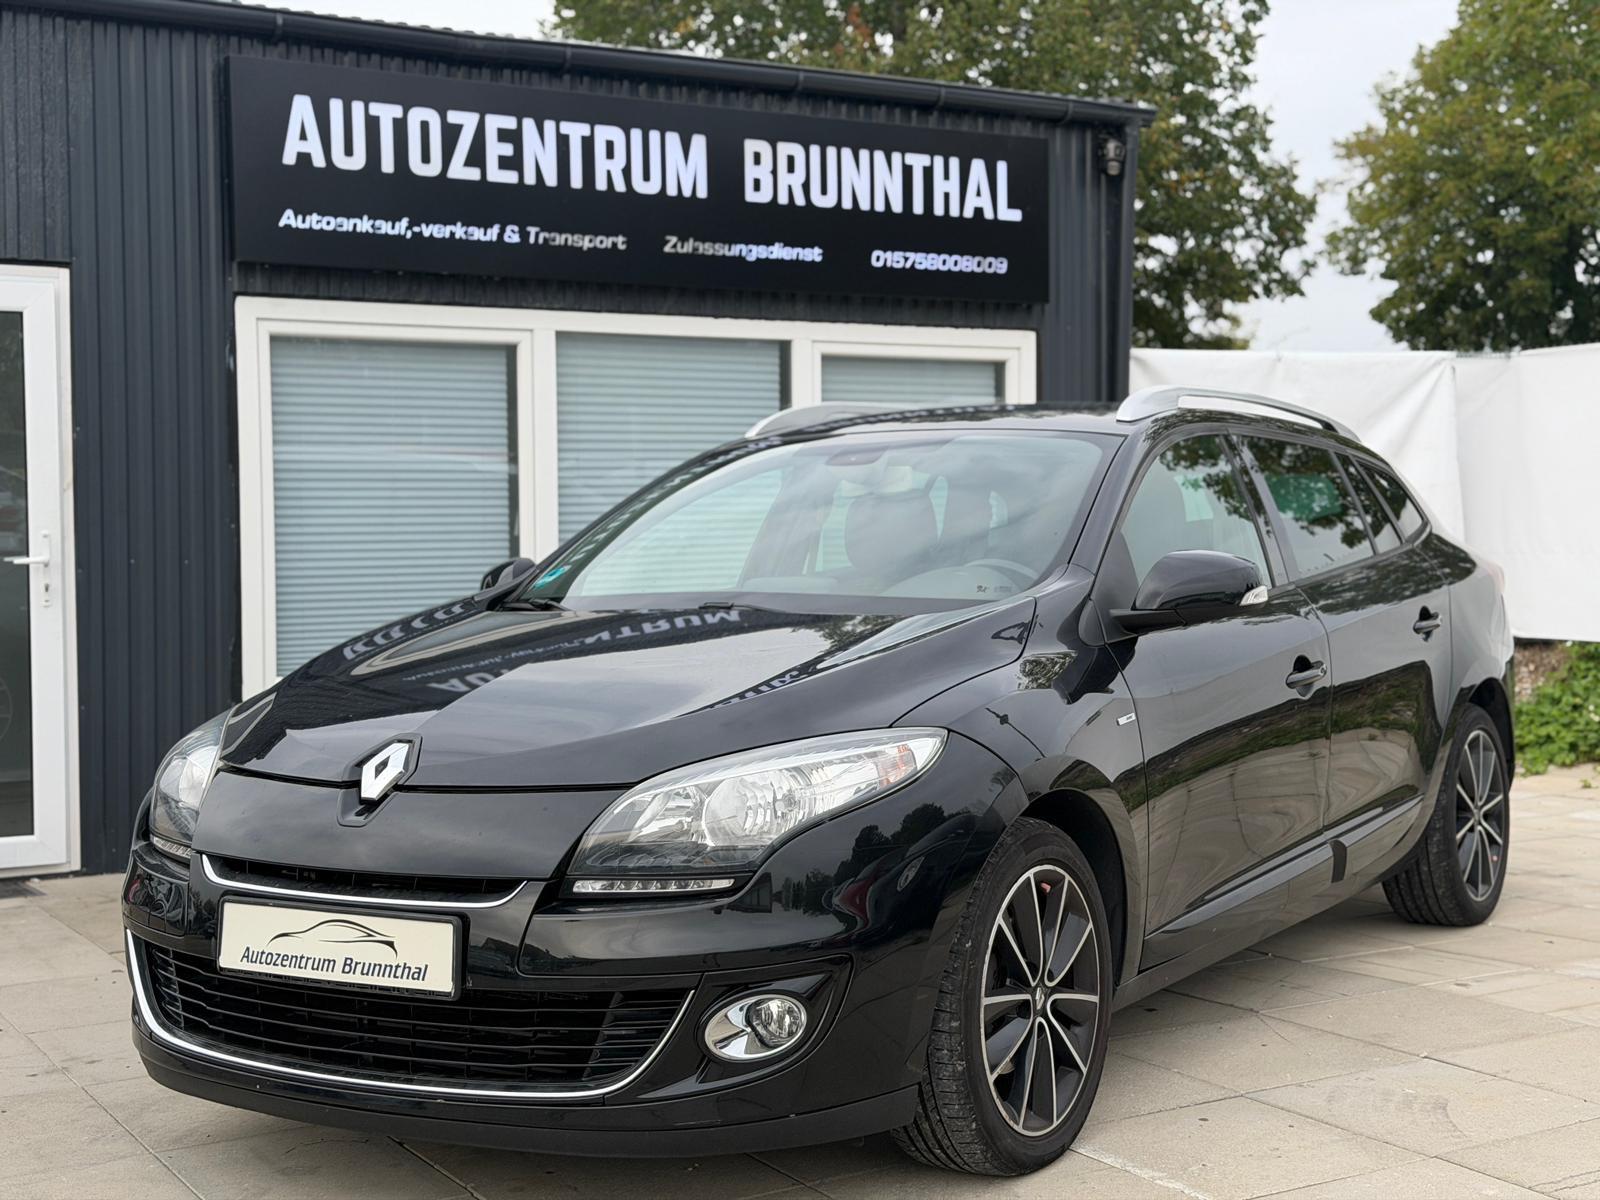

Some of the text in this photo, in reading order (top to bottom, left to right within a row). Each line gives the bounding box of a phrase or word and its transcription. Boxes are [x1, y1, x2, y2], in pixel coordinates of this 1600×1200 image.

[281, 93, 1023, 222] AUTOZENTRUM BRUNNTHAL
[503, 225, 521, 244] &
[525, 225, 627, 251] Transport
[663, 235, 824, 263] Zulassungsdienst
[870, 249, 1009, 275] 015758008009
[240, 946, 429, 982] Autozentrum Brunnthal
